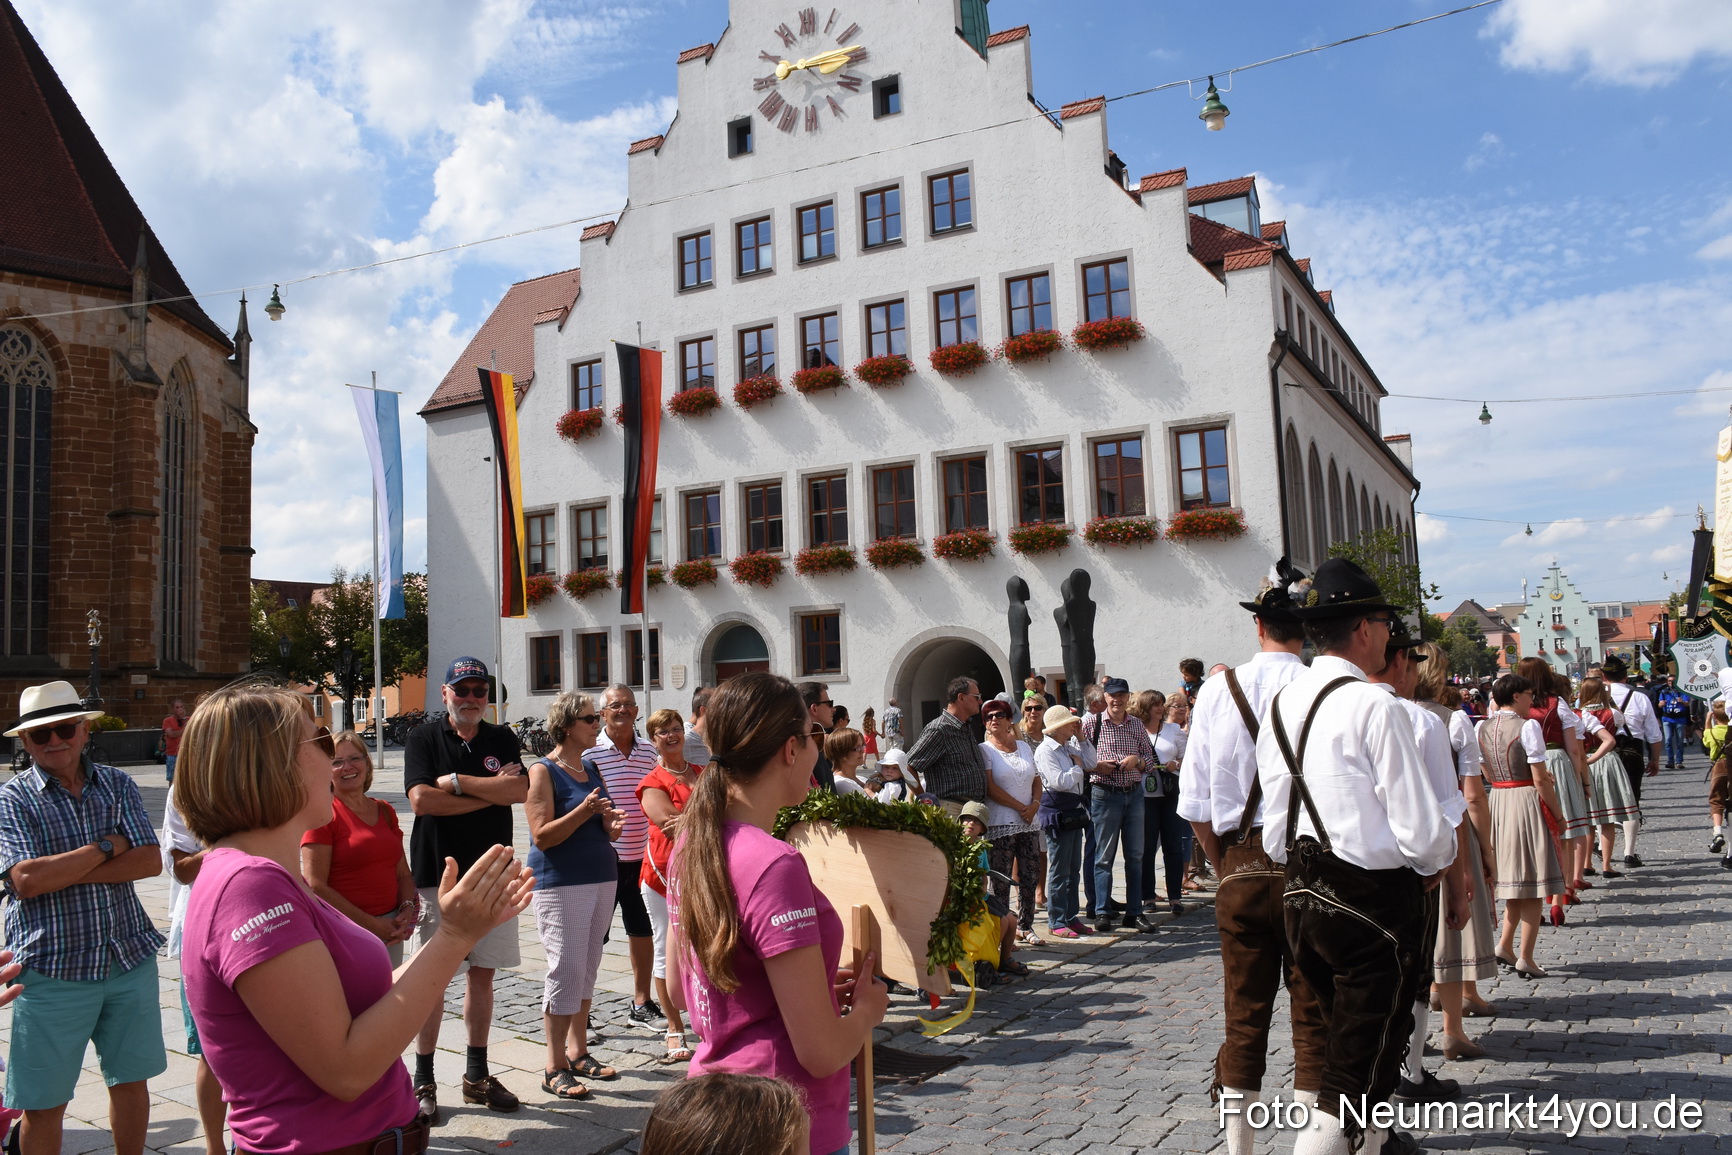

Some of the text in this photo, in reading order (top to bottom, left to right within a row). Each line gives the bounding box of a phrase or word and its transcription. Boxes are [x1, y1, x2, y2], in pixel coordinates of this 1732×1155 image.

[1678, 636, 1718, 648] SCHÜTZENVEREIN
[1684, 644, 1714, 653] JURAHÖHE
[1684, 680, 1720, 692] KEVENHÜ
[231, 902, 294, 942] Gutmann
